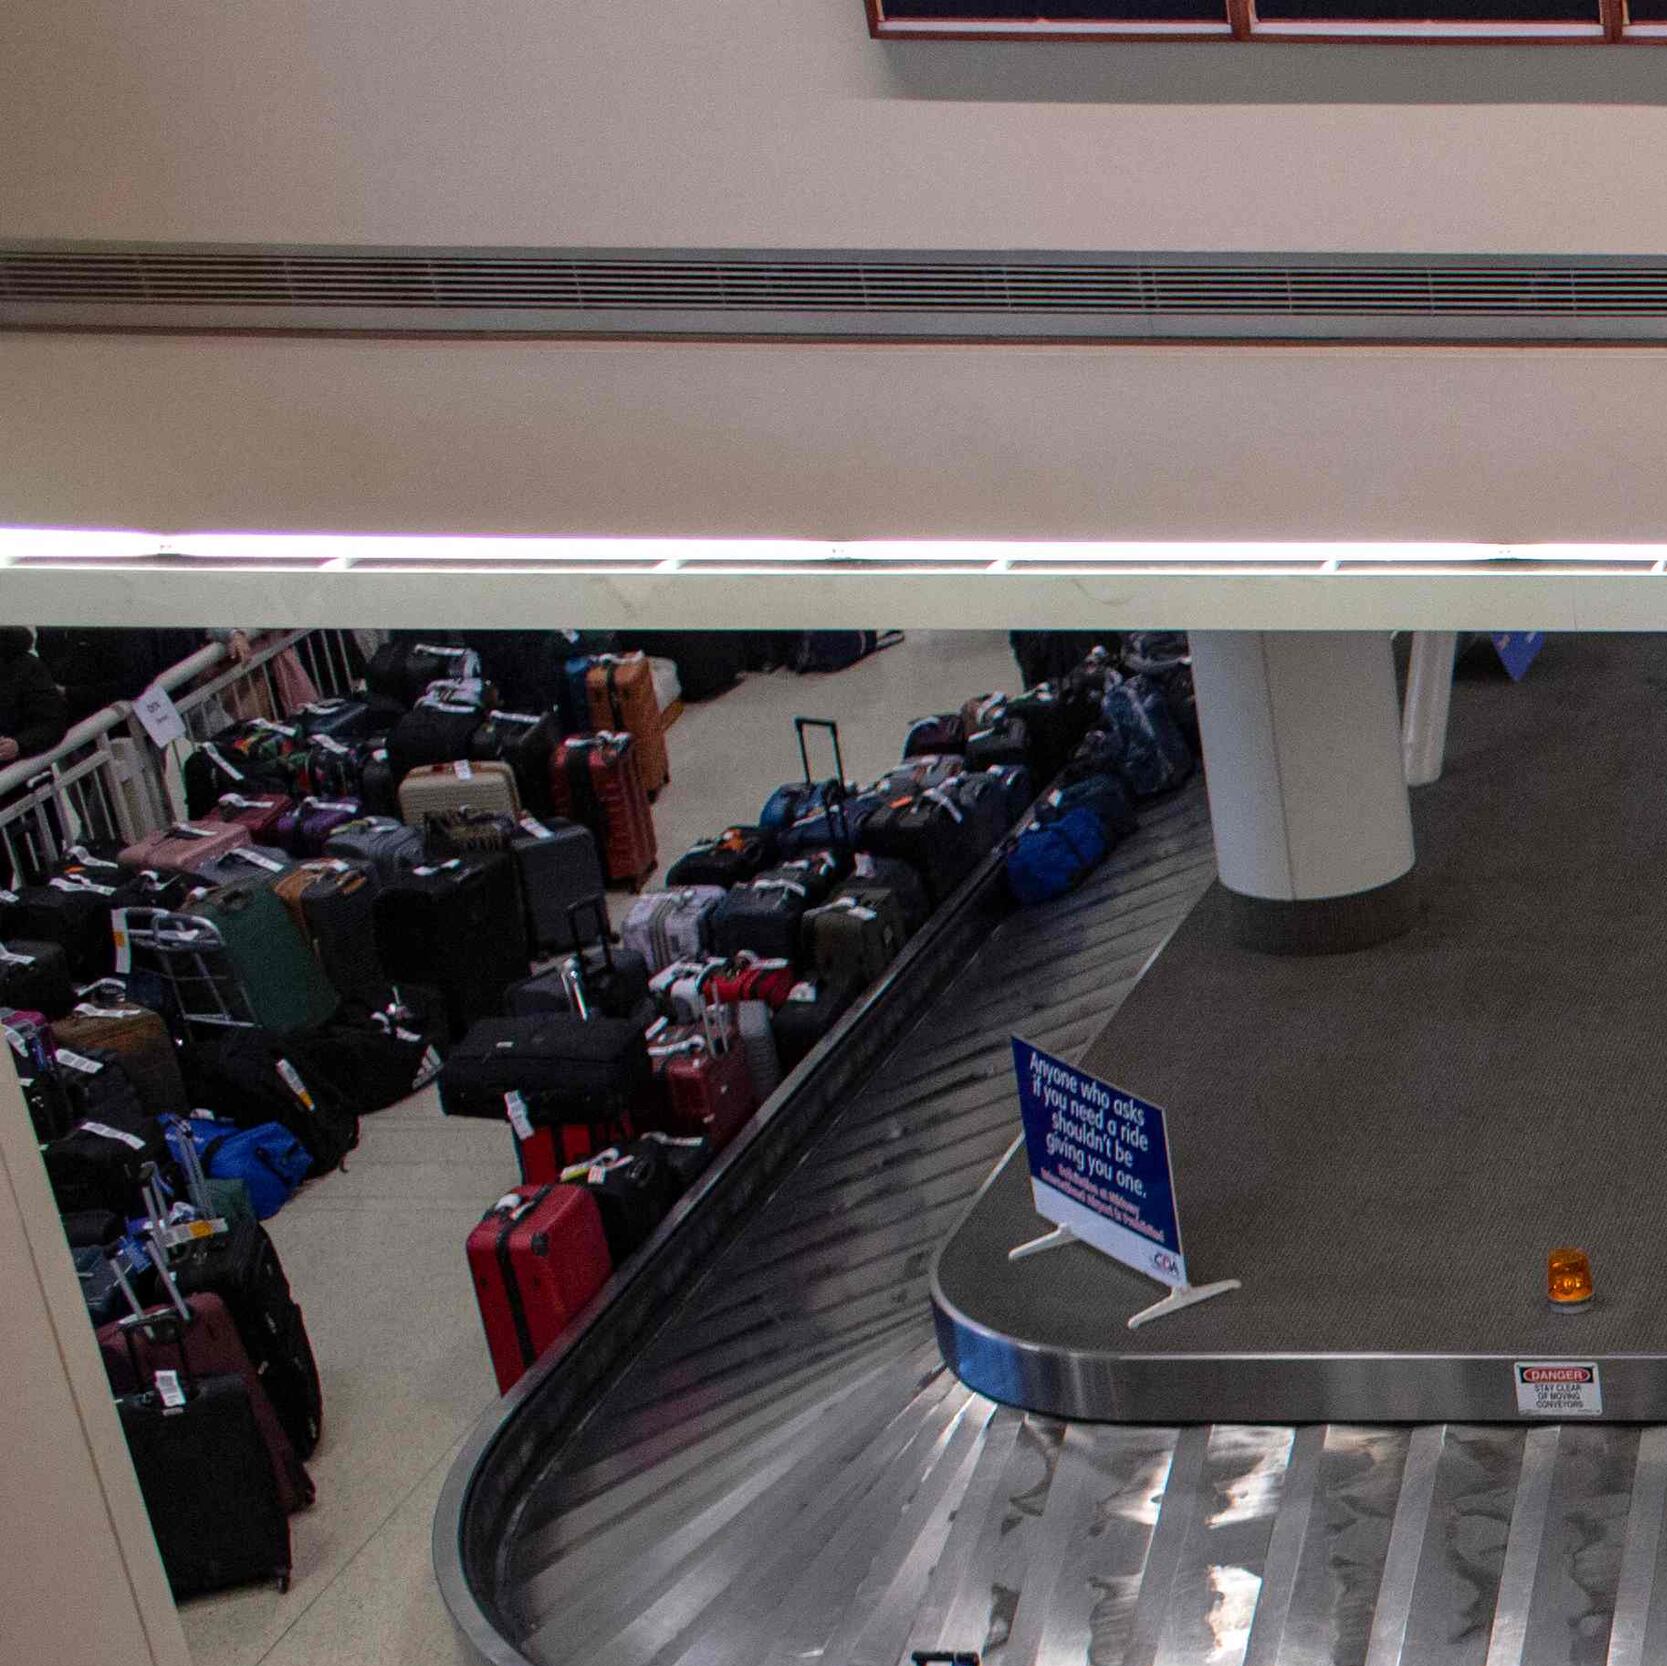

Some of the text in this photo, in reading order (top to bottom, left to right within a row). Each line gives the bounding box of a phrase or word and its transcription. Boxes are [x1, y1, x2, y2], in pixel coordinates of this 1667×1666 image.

[1029, 1051, 1145, 1126] Anyone who asks
[1032, 1073, 1149, 1151] if you need a ride
[1051, 1110, 1134, 1168] shouldn't be
[1046, 1132, 1148, 1198] giving you one.
[1531, 1370, 1583, 1381] DANGER
[1535, 1384, 1582, 1392] STAY CLEAR
[1535, 1400, 1584, 1408] CONVEYORS
[1550, 1392, 1581, 1400] MOVING
